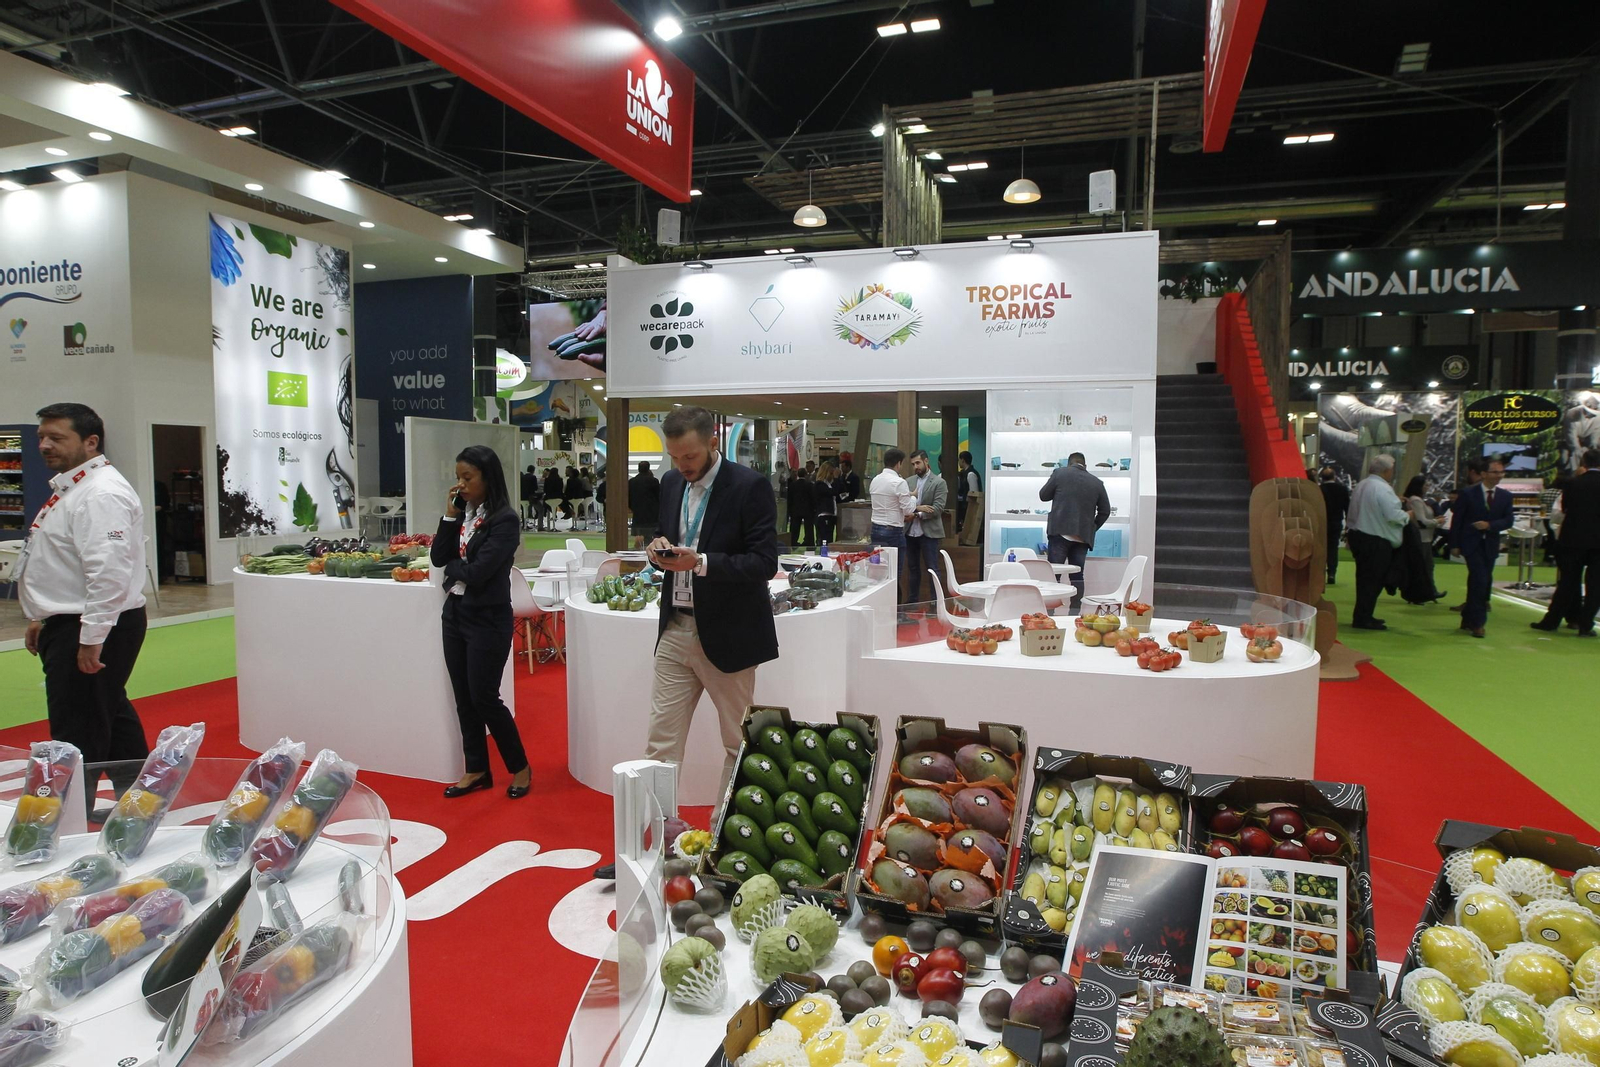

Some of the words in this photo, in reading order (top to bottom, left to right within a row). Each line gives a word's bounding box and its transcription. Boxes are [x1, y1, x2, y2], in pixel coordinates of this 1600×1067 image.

[626, 68, 646, 104] LA
[626, 93, 672, 146] UNION
[55, 284, 78, 296] GRUPO
[1298, 266, 1521, 298] ANDALUCIA
[250, 284, 286, 313] We
[291, 296, 324, 319] are
[966, 282, 1072, 303] TROPICAL
[982, 301, 1055, 321] FARMS
[640, 319, 704, 331] wecarepack
[985, 319, 1017, 338] exotic
[1018, 314, 1049, 338] fruits
[250, 317, 330, 358] Organic
[86, 344, 115, 354] cañada
[390, 348, 415, 364] you
[418, 344, 448, 360] add
[393, 370, 446, 390] value
[393, 397, 407, 411] to
[410, 396, 446, 410] what
[1468, 410, 1502, 419] FRUTAS
[1503, 410, 1521, 419] LOS
[1521, 410, 1558, 419] CURSOS
[252, 429, 281, 439] Somos
[282, 431, 322, 441] ecológicos
[1086, 951, 1100, 959] we
